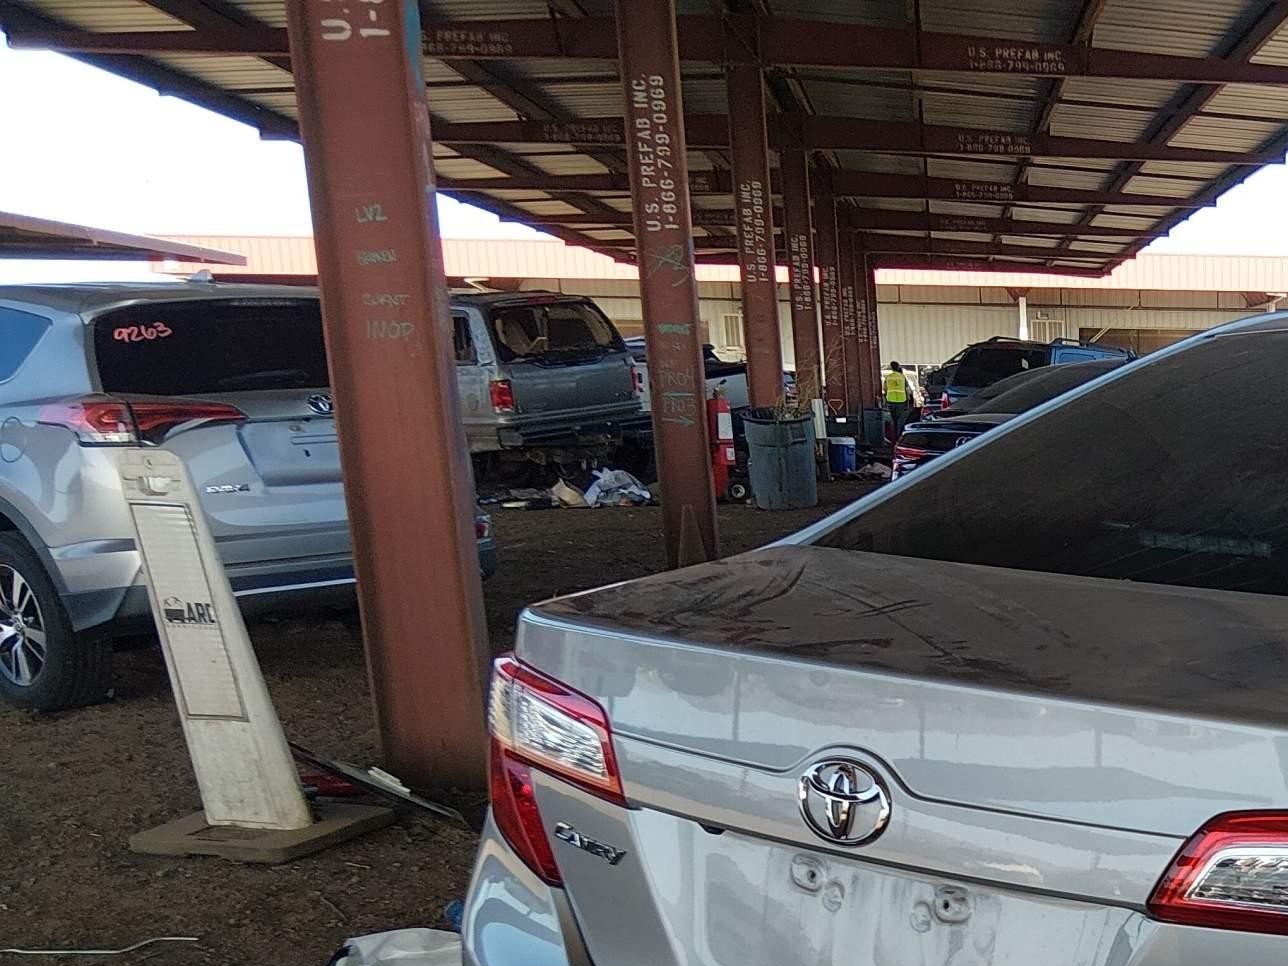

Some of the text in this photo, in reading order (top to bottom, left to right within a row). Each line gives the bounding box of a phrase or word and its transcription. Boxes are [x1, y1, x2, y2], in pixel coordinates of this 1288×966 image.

[320, 0, 352, 40] U.
[360, 0, 391, 38] 1-
[967, 46, 989, 58] U.S.
[995, 47, 1040, 60] PREFAB
[631, 73, 662, 232] U.S. PREFAB INC.
[649, 74, 680, 231] 1-866-799-0969
[741, 208, 756, 255] PREFAB
[746, 260, 757, 283] U.S.
[113, 321, 173, 343] 9263
